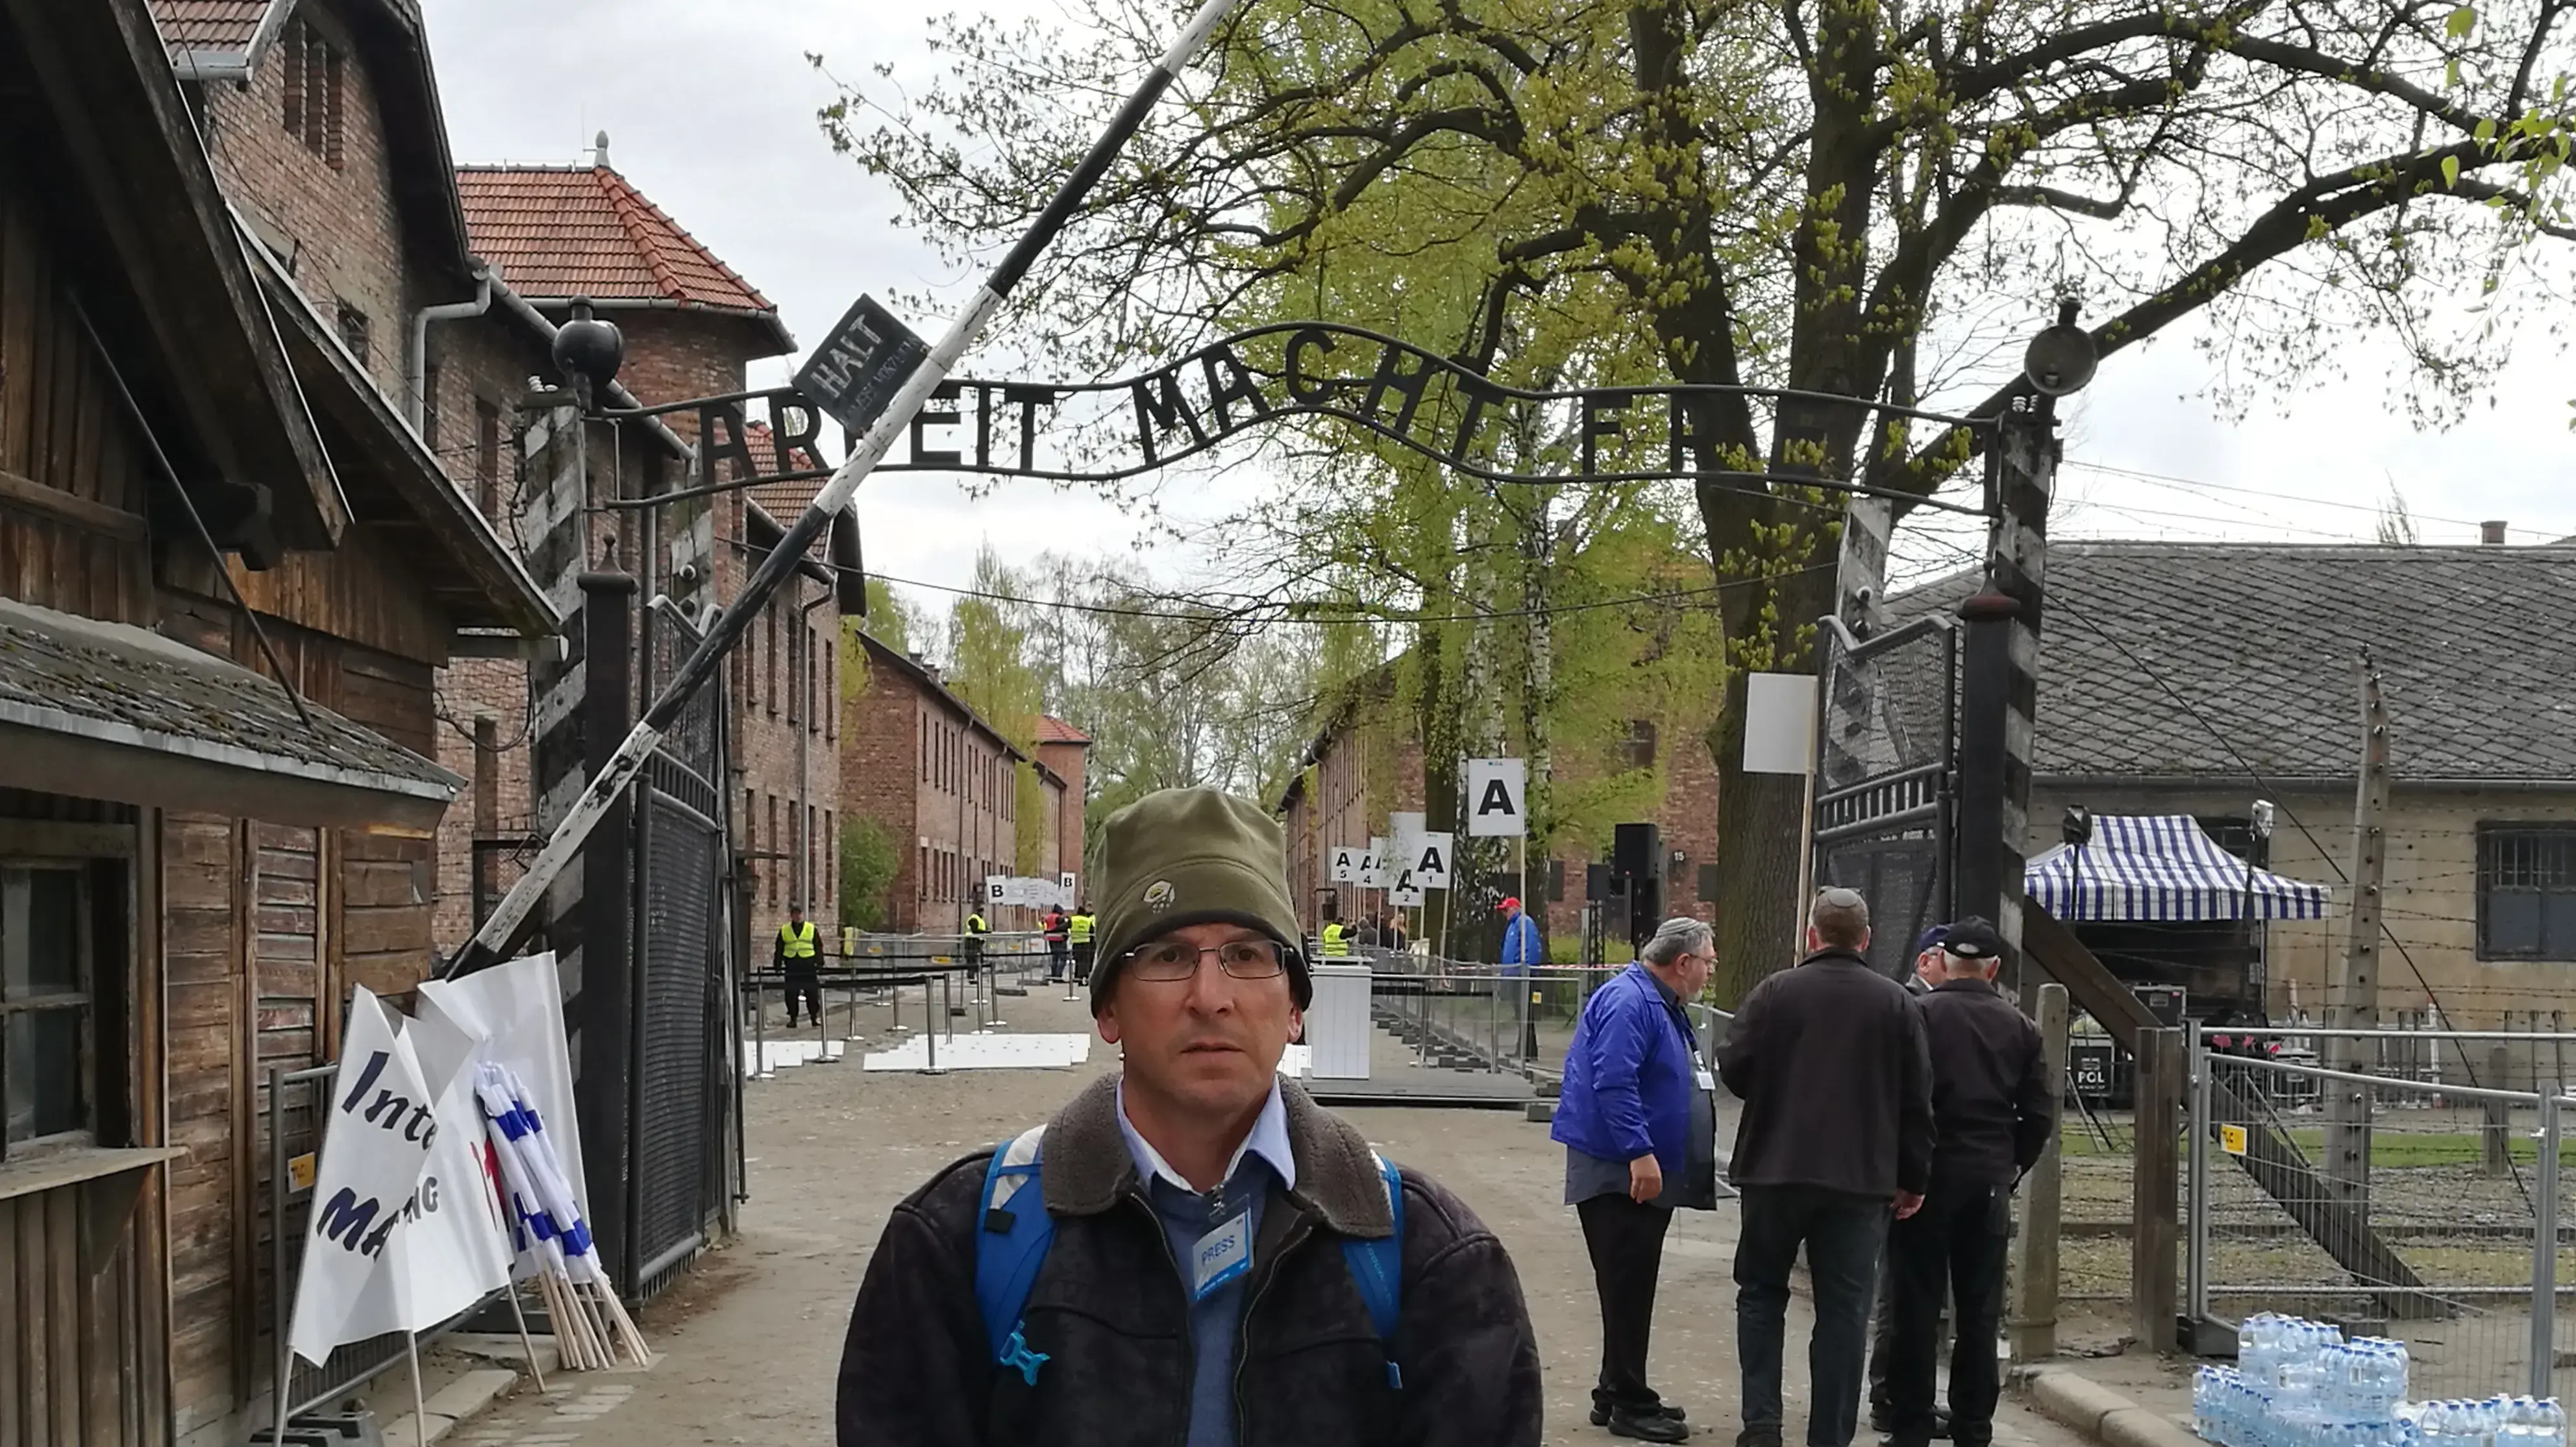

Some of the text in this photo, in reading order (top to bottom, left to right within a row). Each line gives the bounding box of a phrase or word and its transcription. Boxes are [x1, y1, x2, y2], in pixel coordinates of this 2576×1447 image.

[810, 314, 884, 399] HALT
[699, 388, 1055, 482] AREIT
[1132, 328, 1506, 463] MACHT
[1478, 779, 1516, 815] A
[1336, 852, 1351, 867] A
[1359, 856, 1371, 871] A
[1417, 847, 1444, 874] A
[991, 885, 1004, 897] B
[1064, 878, 1072, 887] B
[1363, 875, 1372, 884] 4
[1395, 869, 1420, 893] A
[1201, 1235, 1236, 1266] PRESS
